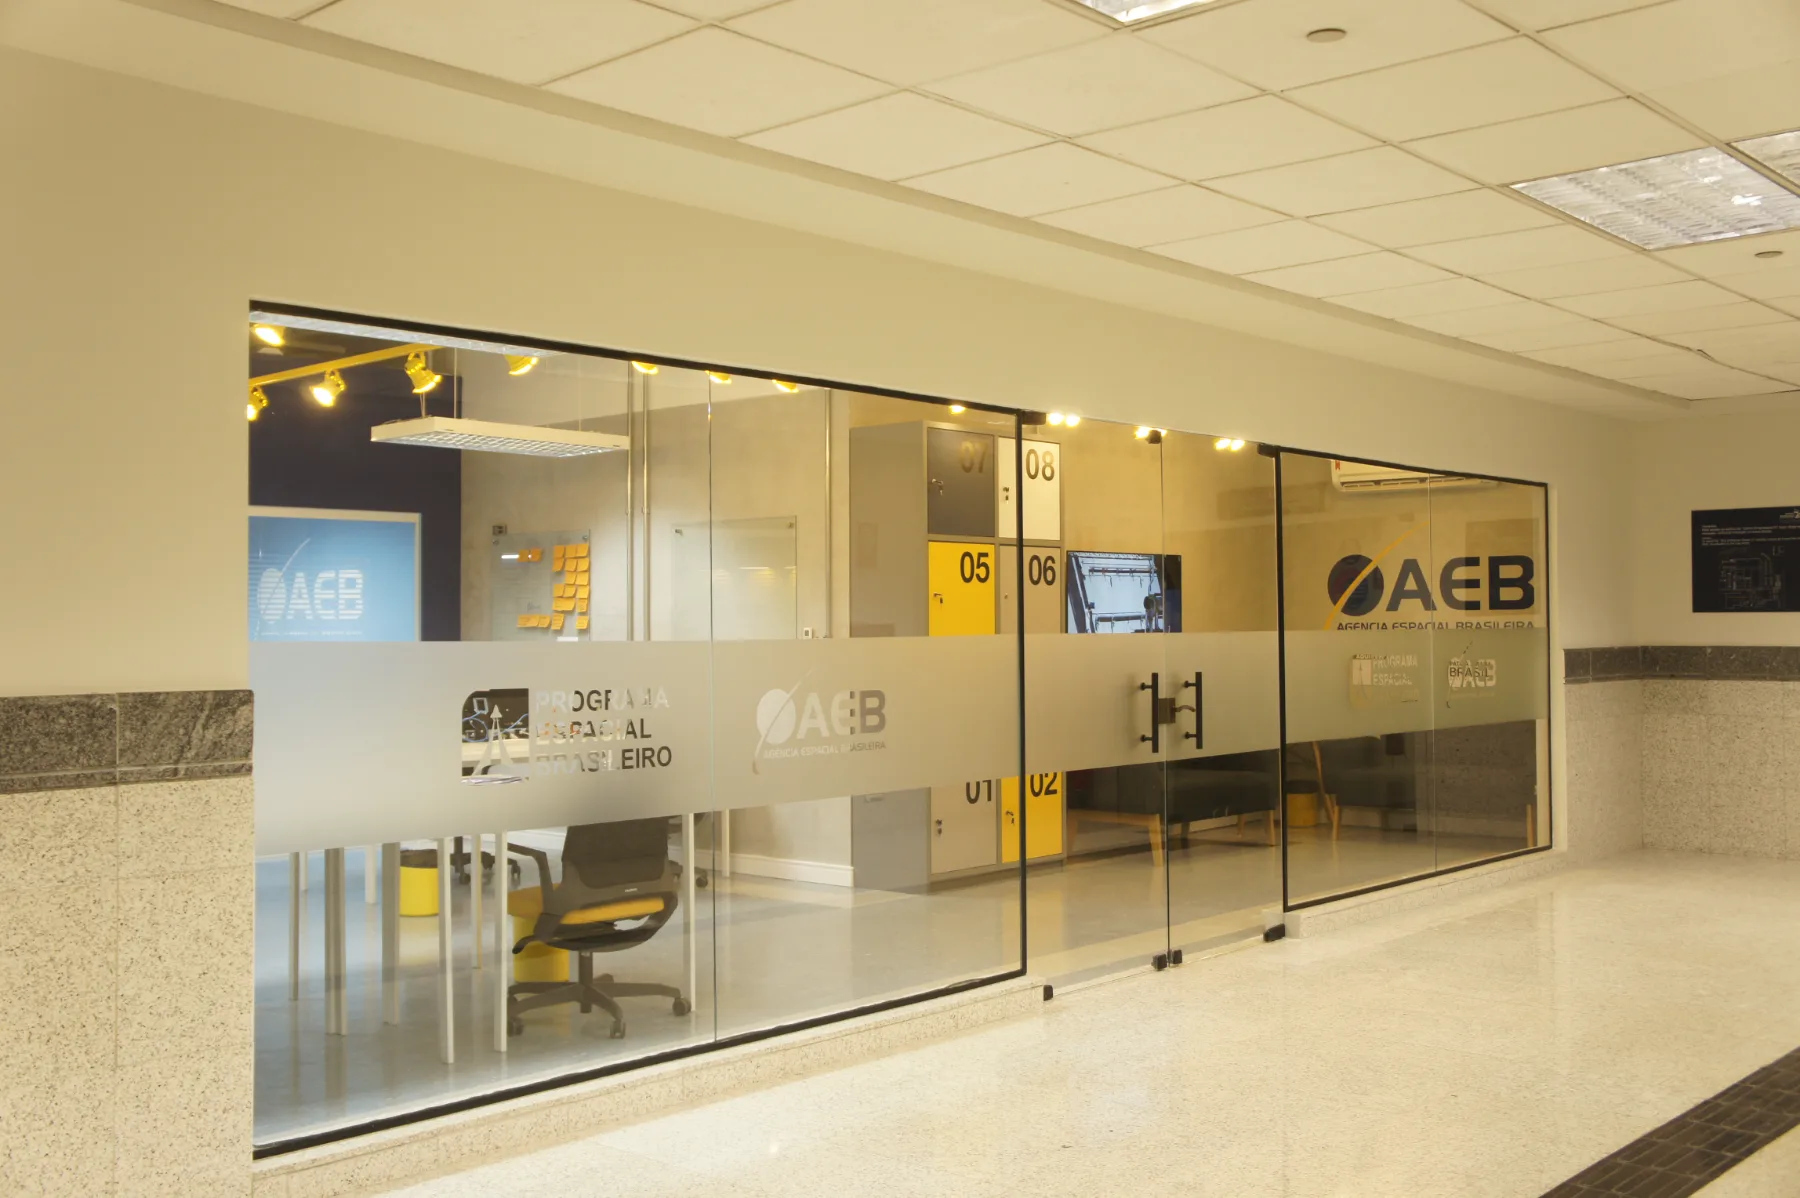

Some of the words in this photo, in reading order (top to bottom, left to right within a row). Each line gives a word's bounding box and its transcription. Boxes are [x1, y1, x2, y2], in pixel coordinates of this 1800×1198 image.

[960, 441, 989, 474] 07
[1025, 449, 1055, 482] 08
[960, 551, 990, 584] 05
[1028, 554, 1056, 586] 06
[1385, 555, 1535, 612] AEB
[285, 569, 364, 620] AEB
[535, 687, 670, 714] PROGRAMA
[796, 689, 886, 739] AEB
[535, 718, 652, 746] ESPACIAL
[535, 746, 672, 776] BRASILEIRO
[965, 780, 992, 805] 01
[1029, 772, 1058, 798] 02
